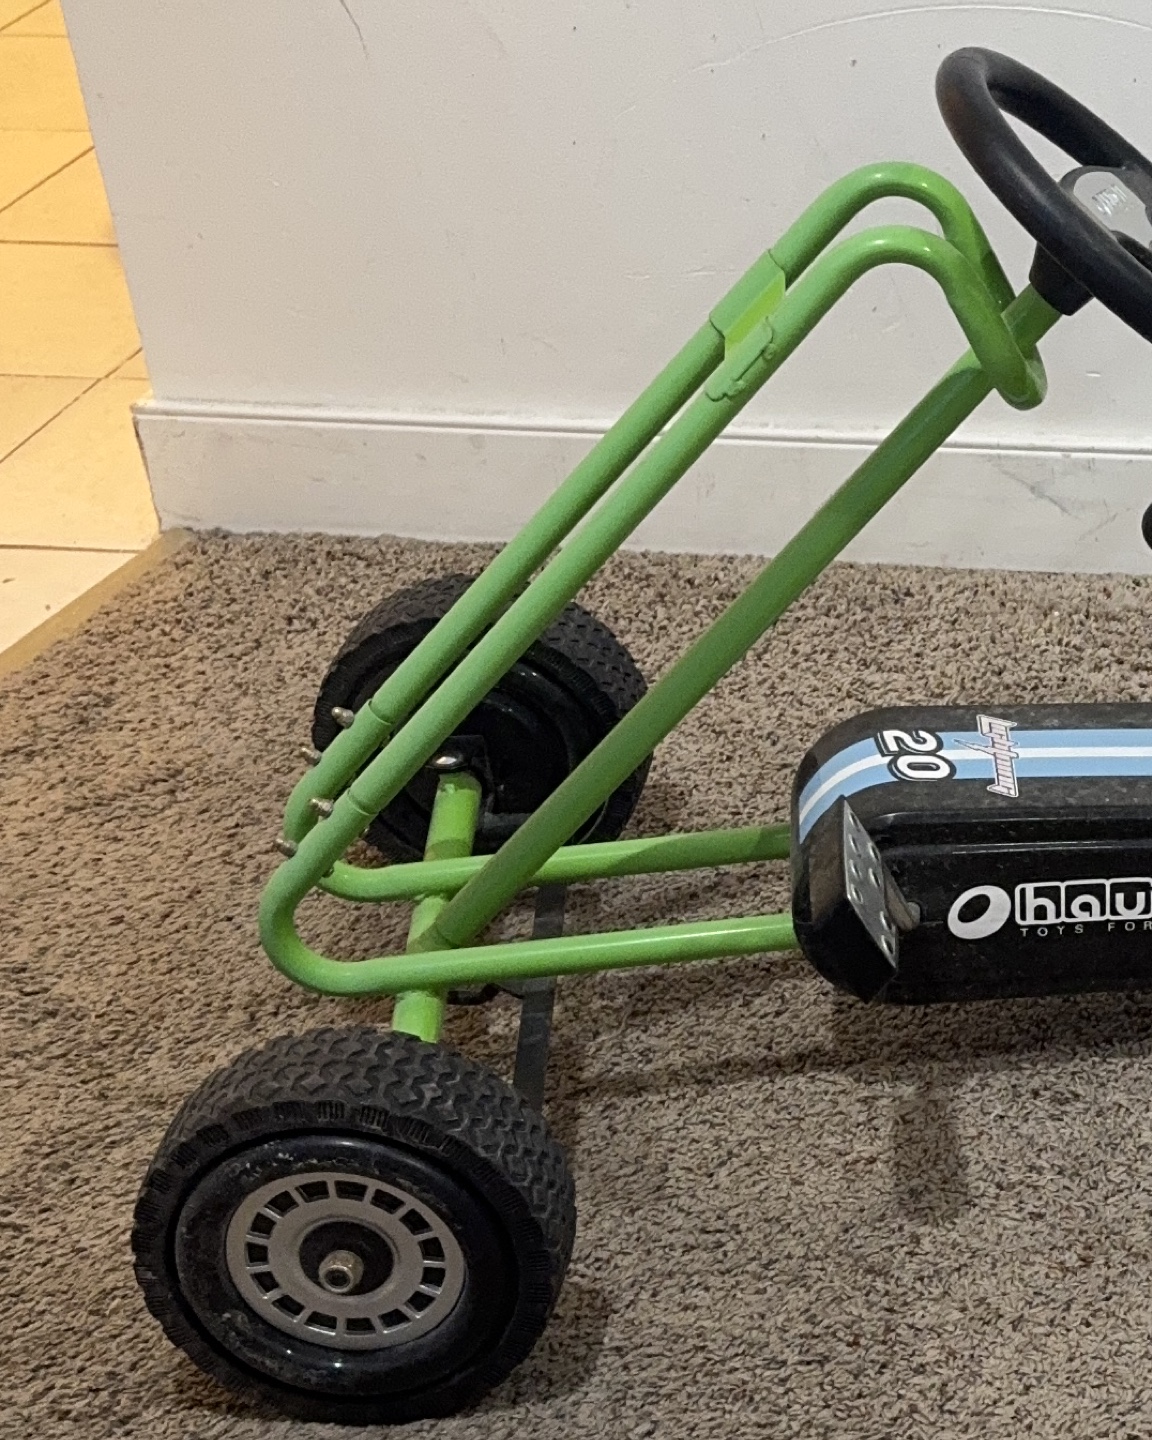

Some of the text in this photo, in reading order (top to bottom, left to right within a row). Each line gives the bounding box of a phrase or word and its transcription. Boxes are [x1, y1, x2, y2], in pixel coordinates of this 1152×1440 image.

[878, 728, 953, 781] 20
[1019, 923, 1084, 938] TOYS
[1107, 919, 1152, 932] FOR
